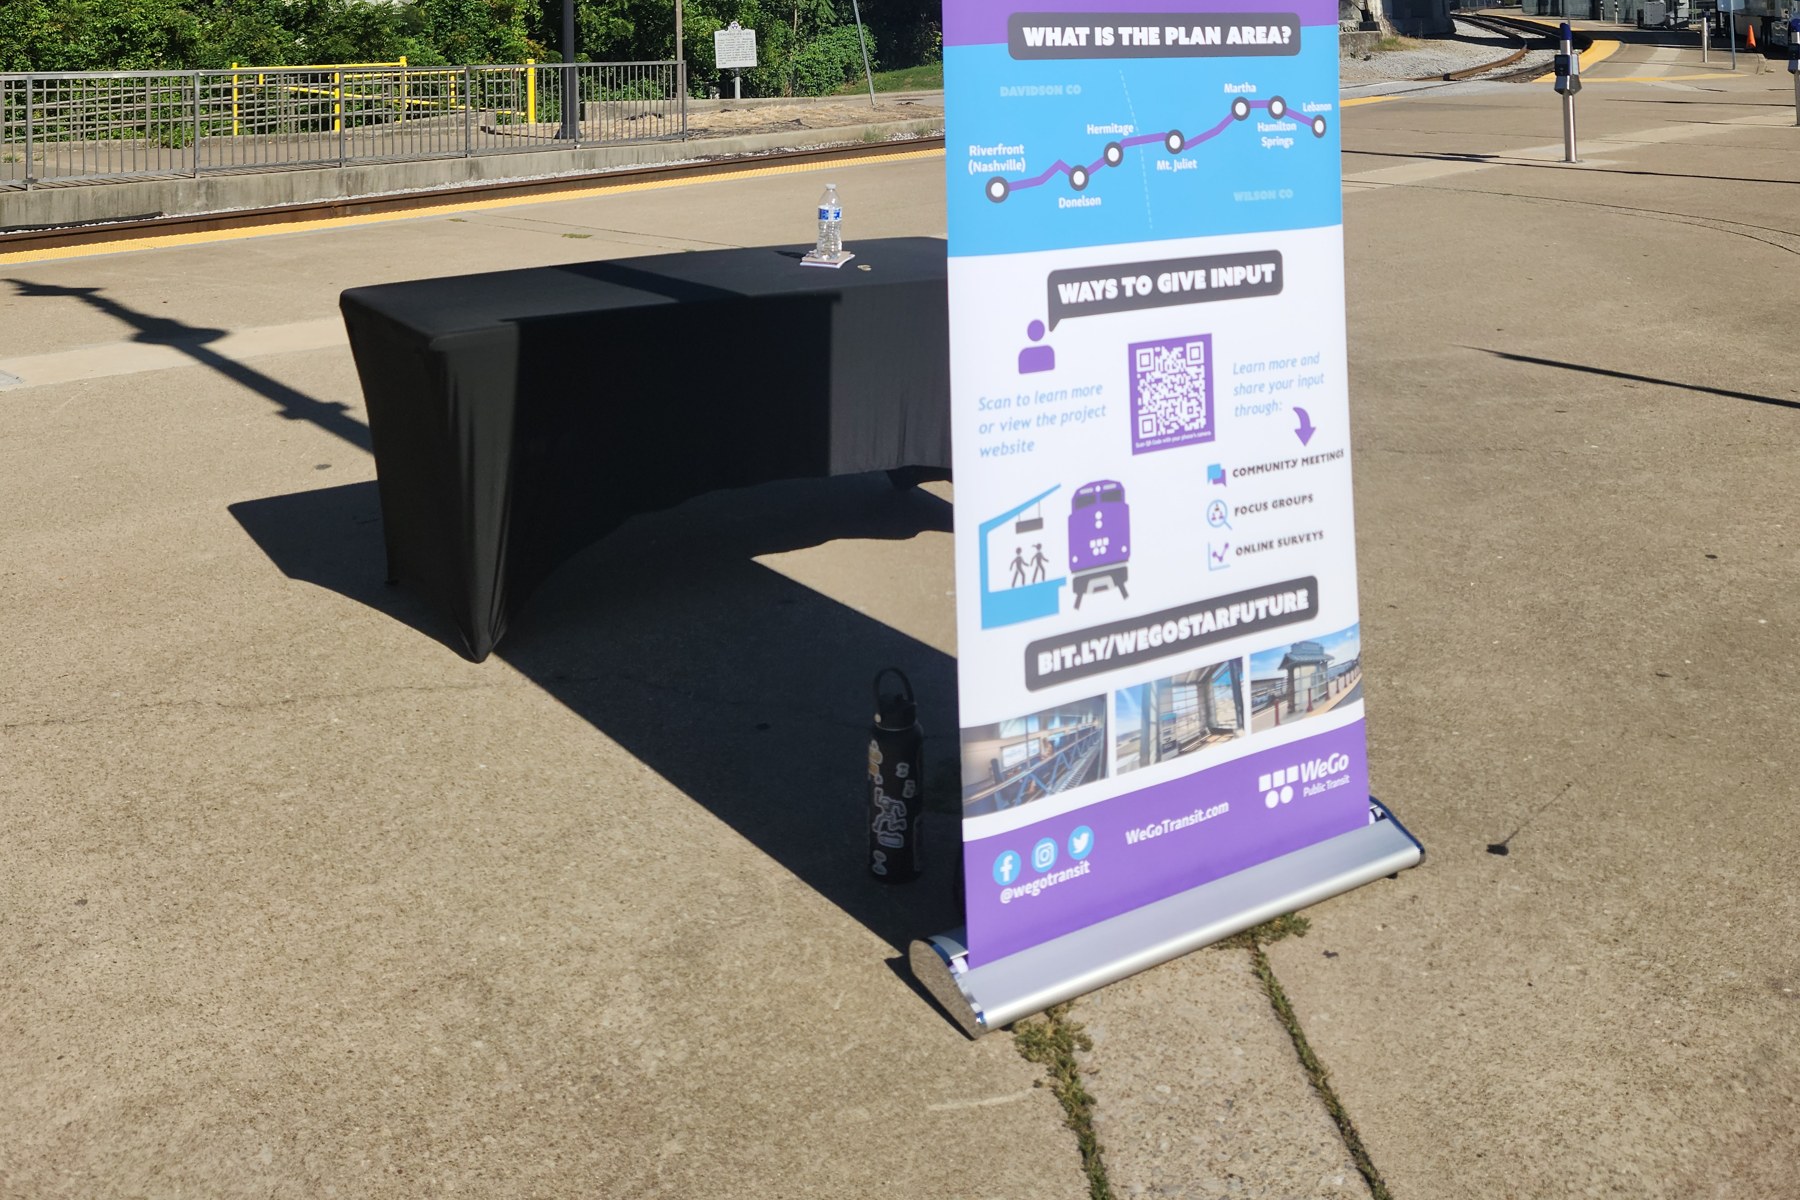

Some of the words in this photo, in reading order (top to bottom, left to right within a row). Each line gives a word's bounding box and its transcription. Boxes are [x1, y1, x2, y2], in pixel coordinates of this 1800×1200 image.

[1023, 27, 1090, 47] WHAT
[1095, 27, 1115, 46] IS
[1118, 26, 1160, 46] THE
[1165, 25, 1222, 46] PLAN
[1226, 25, 1292, 45] AREA?
[1000, 85, 1063, 97] DAVIDSON
[1066, 84, 1082, 95] CO
[1224, 82, 1257, 94] Martha
[1302, 101, 1333, 112] Lebanon
[1087, 122, 1134, 136] Hermitage
[1257, 121, 1297, 132] Hamilton
[969, 144, 1024, 157] Riverfront
[1261, 136, 1294, 149] Springs
[968, 157, 1026, 175] (Nashville)
[1156, 160, 1172, 171] Mt.
[1173, 158, 1198, 172] Juliet
[1058, 195, 1101, 209] Donelson
[1233, 190, 1276, 202] WILSON
[1279, 188, 1294, 199] CO
[1057, 278, 1118, 304] WAYS
[1121, 275, 1152, 297] TO
[1157, 270, 1206, 294] GIVE
[1211, 263, 1276, 288] INPUT
[1233, 362, 1265, 375] Learn
[1268, 357, 1298, 370] more
[1300, 351, 1320, 366] and
[1233, 382, 1265, 396] share
[1268, 378, 1294, 395] your
[1298, 373, 1324, 389] input
[978, 391, 1011, 411] Scan
[1017, 393, 1031, 406] to
[1034, 388, 1068, 405] learn
[1072, 383, 1103, 398] more
[1234, 400, 1282, 418] through:
[979, 420, 994, 435] or
[1000, 413, 1031, 432] view
[1036, 408, 1057, 427] the
[1060, 404, 1106, 429] project
[979, 438, 1035, 458] website
[1232, 458, 1299, 478] COMMUNITY
[1234, 501, 1268, 517] FOCUS
[1271, 493, 1314, 509] GROUPS
[1235, 539, 1274, 556] ONLINE
[1277, 530, 1324, 548] SURVEYS
[1037, 589, 1310, 676] BIT.LY/WEGOSTARFUTURE
[1300, 752, 1350, 784] WeGo
[1303, 782, 1326, 798] Public
[1325, 774, 1350, 792] Transit
[1125, 801, 1229, 846] WeGoTransit.com
[999, 860, 1091, 904] @wegotransit
